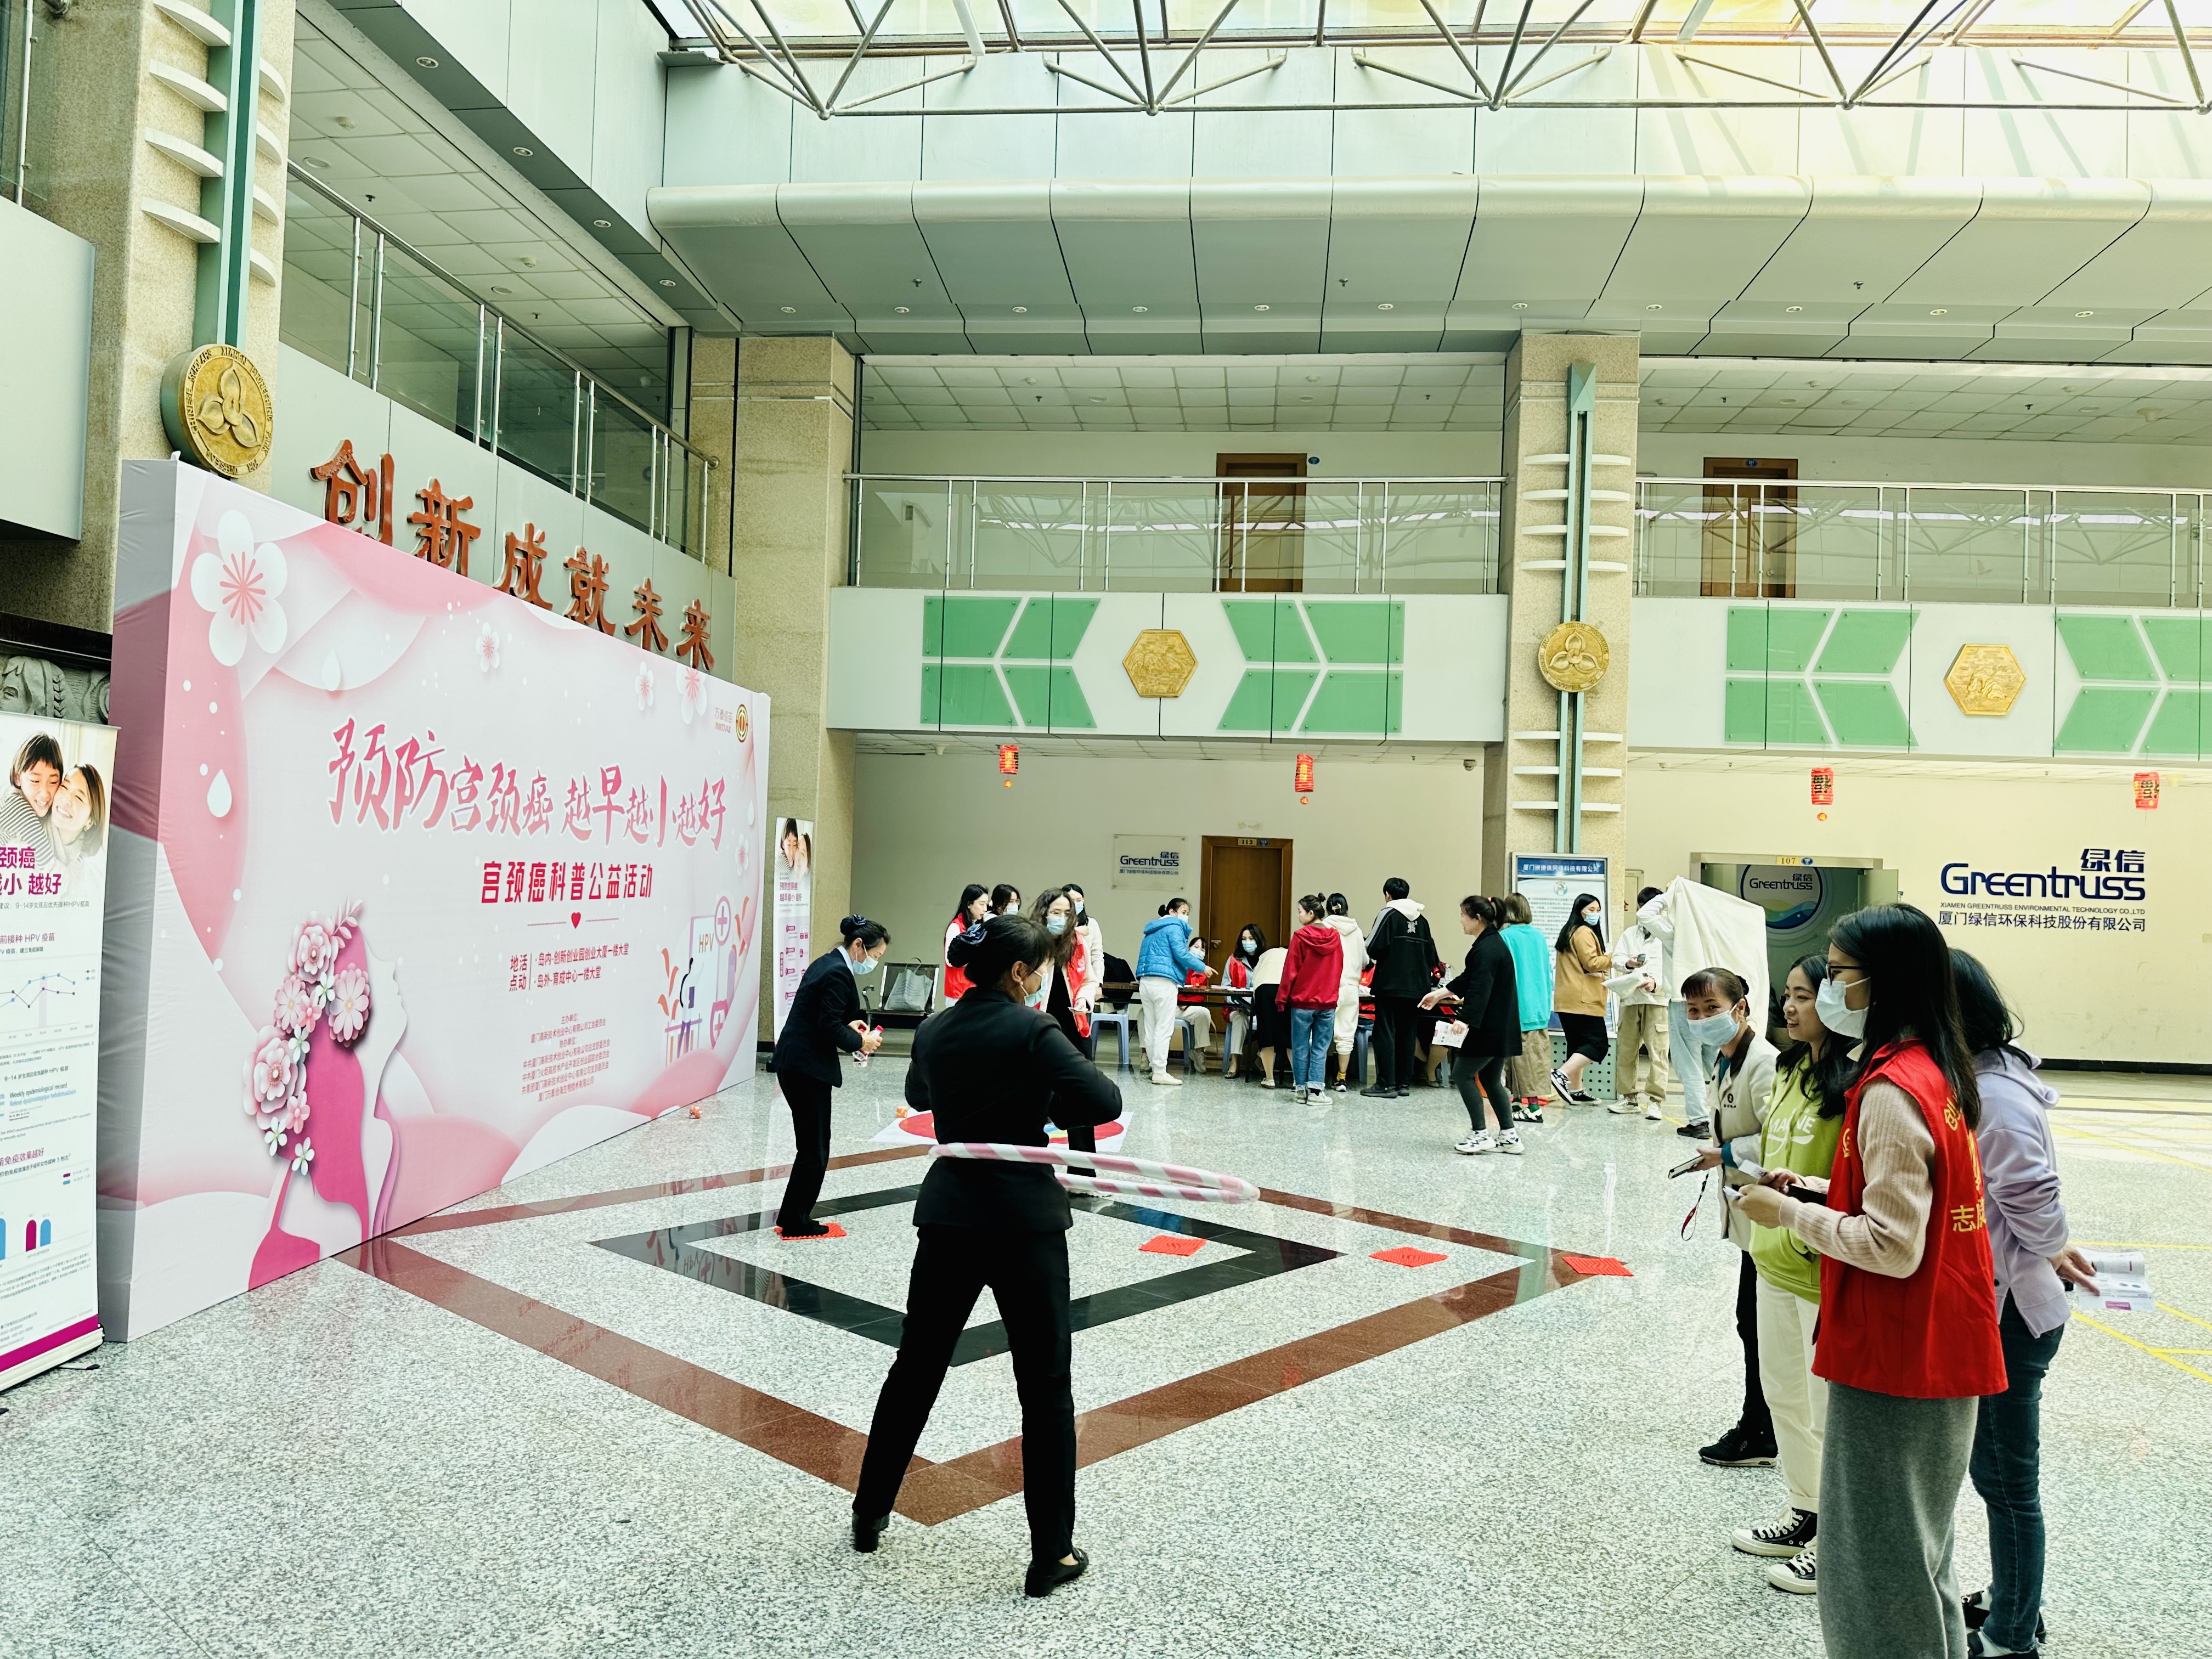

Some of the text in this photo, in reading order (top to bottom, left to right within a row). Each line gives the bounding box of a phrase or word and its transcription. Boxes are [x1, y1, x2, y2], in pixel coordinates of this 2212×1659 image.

[329, 717, 554, 836] 预防宫颈癌
[1120, 855, 1179, 867] Greentruss
[2080, 849, 2146, 873] 绿信
[0, 873, 61, 895] 小 越好
[481, 861, 652, 904] 宫颈癌科普公益活动
[1750, 878, 1813, 890] Greentruss
[1940, 863, 2146, 901] Greentruss
[1938, 911, 2146, 932] 厦门绿信环保科技股份有限公司
[25, 934, 40, 943] HPV
[42, 933, 55, 941] 疫苗
[699, 933, 714, 953] HPV
